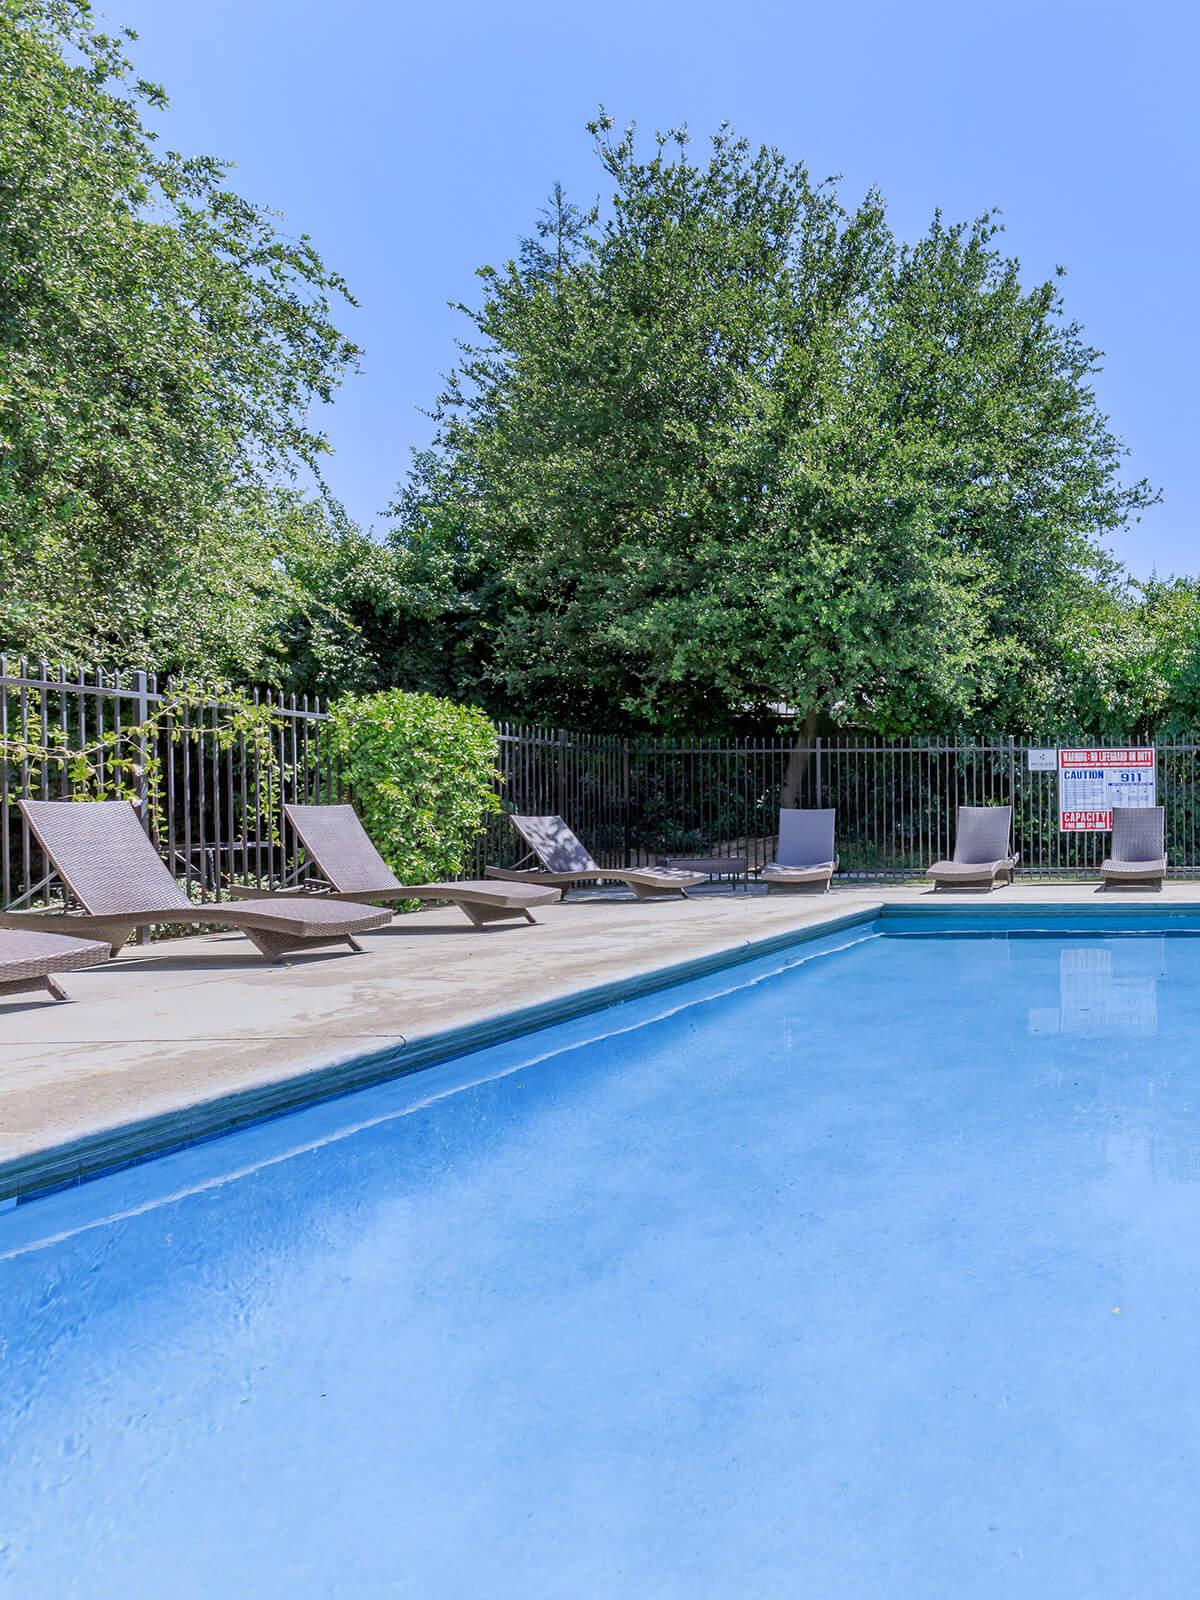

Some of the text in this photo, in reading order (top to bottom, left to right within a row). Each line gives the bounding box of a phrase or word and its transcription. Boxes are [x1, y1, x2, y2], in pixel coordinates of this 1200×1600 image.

[1063, 770, 1104, 780] CAUTION
[1120, 772, 1142, 783] 911
[1064, 811, 1106, 823] CAPACITY
